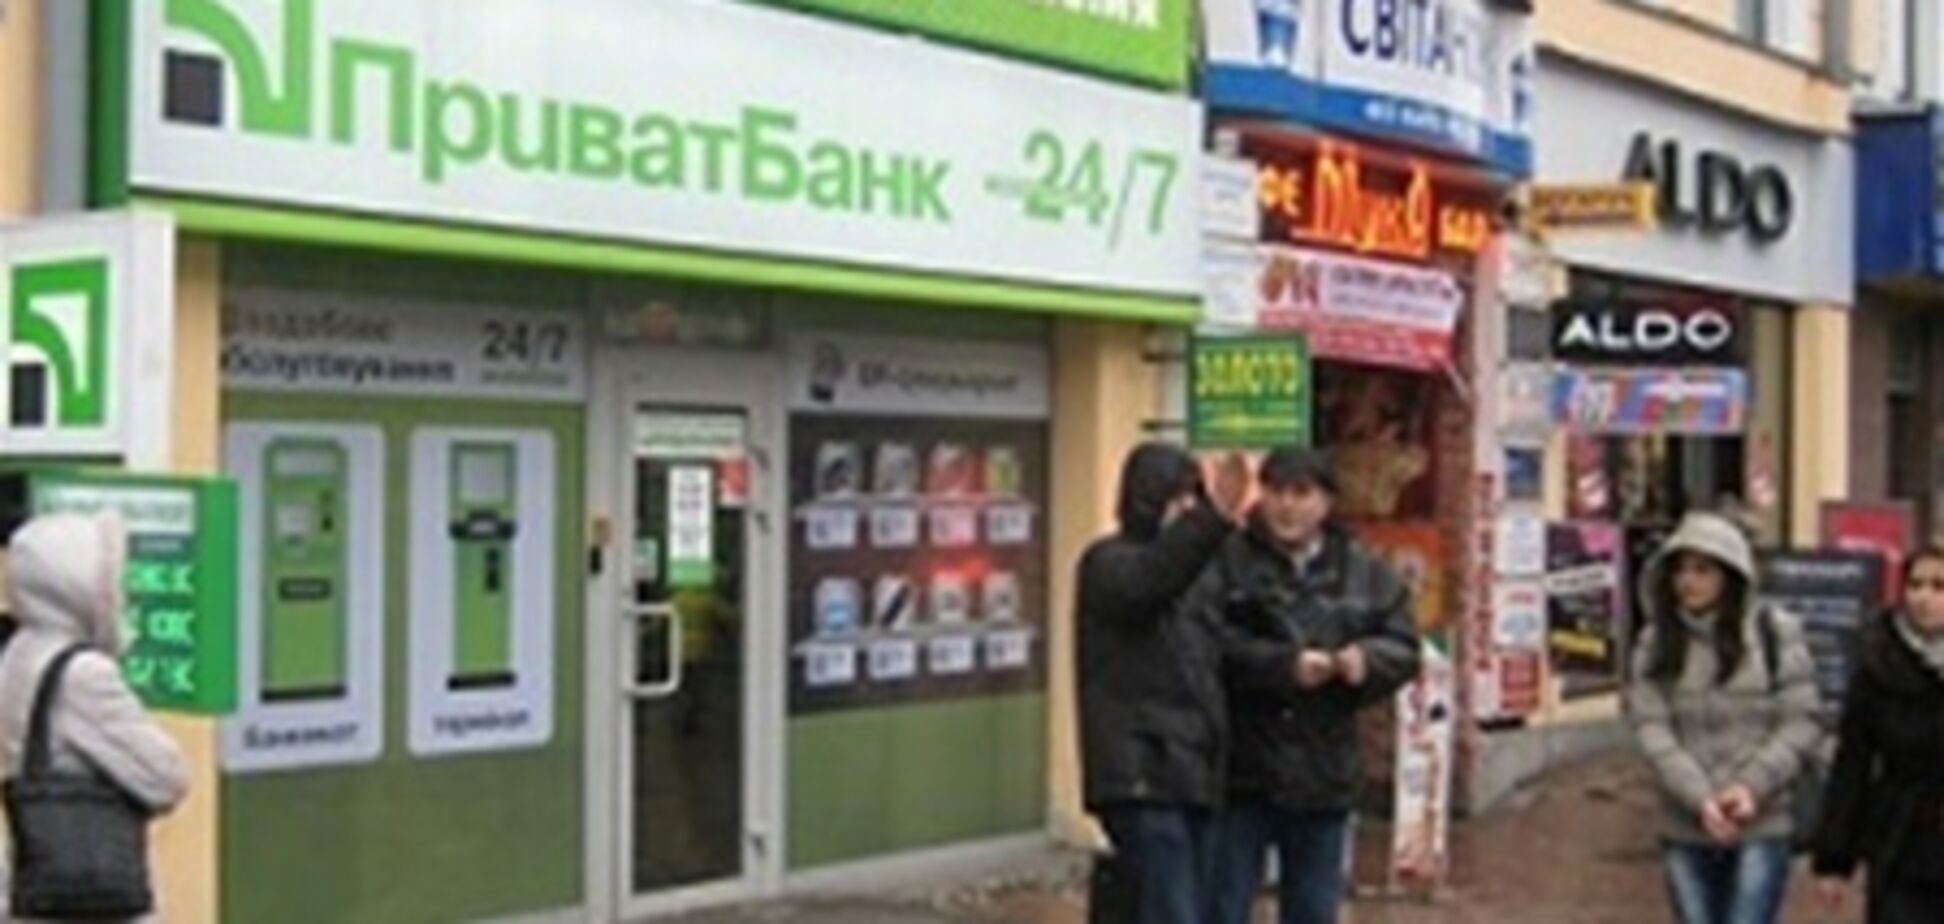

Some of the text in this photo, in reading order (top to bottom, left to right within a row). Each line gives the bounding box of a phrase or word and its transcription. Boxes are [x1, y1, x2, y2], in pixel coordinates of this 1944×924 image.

[329, 38, 954, 224] ПриватБанк
[1622, 130, 1795, 246] ALDO
[480, 317, 570, 368] 24/7
[1559, 310, 1732, 350] ALDO
